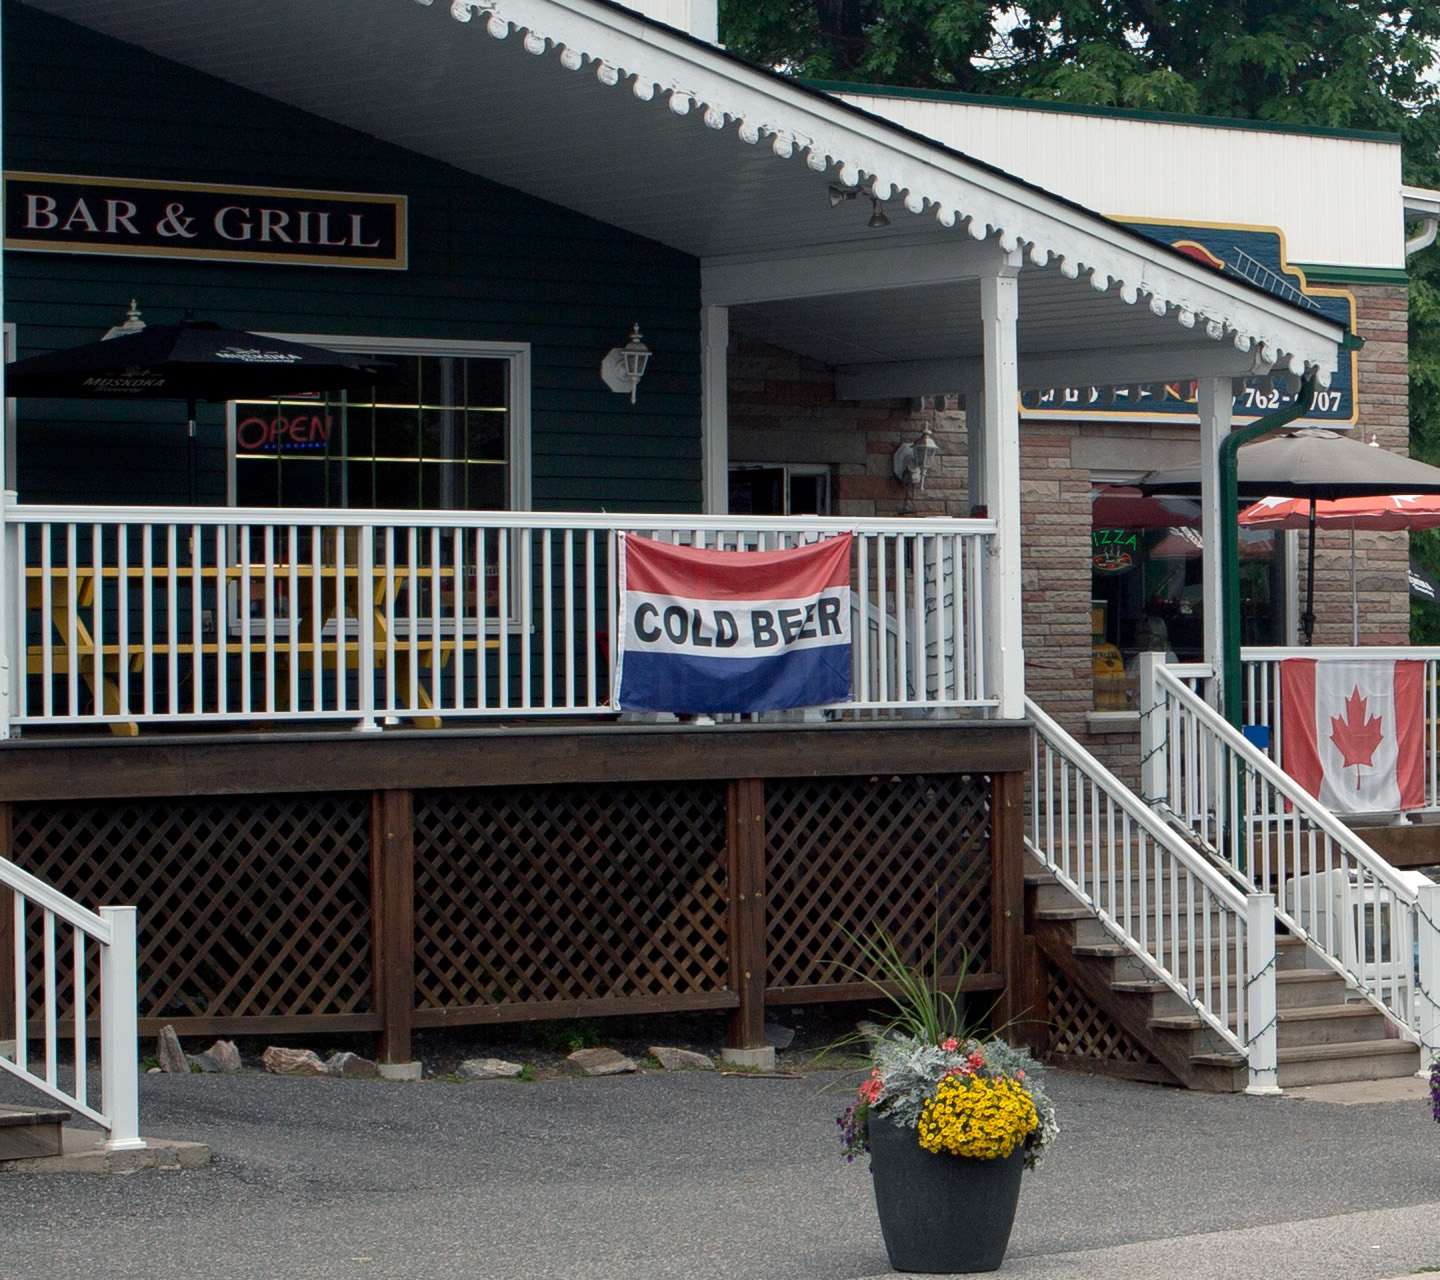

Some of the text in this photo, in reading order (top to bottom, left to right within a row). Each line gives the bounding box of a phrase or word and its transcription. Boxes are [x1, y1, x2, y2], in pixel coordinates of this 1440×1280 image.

[22, 194, 381, 249] BAR & GRILL
[82, 377, 166, 387] MUSKOKA
[236, 415, 333, 449] OPEN
[1093, 529, 1138, 552] IZZA
[633, 596, 843, 649] COLD BEER
